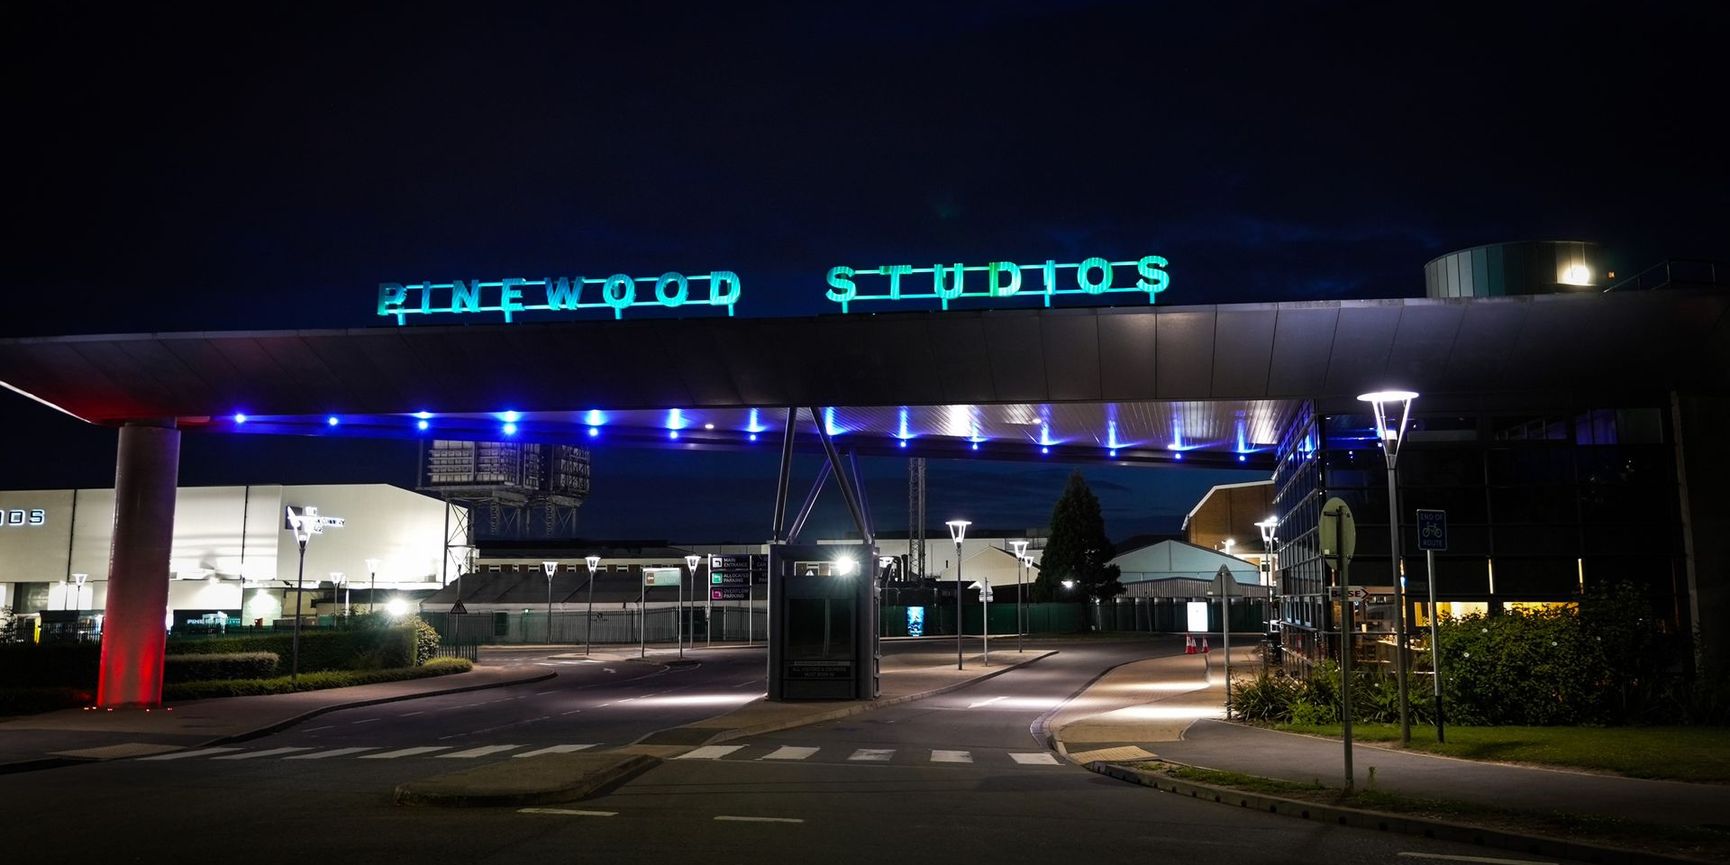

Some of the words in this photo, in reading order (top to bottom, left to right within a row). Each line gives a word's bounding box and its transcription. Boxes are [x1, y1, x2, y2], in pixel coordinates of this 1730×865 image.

[377, 270, 740, 316] PINEWOOD
[826, 255, 1170, 302] STUDIOS
[1420, 513, 1434, 521] END
[1434, 513, 1443, 521] OF
[1422, 539, 1442, 547] ROUTE
